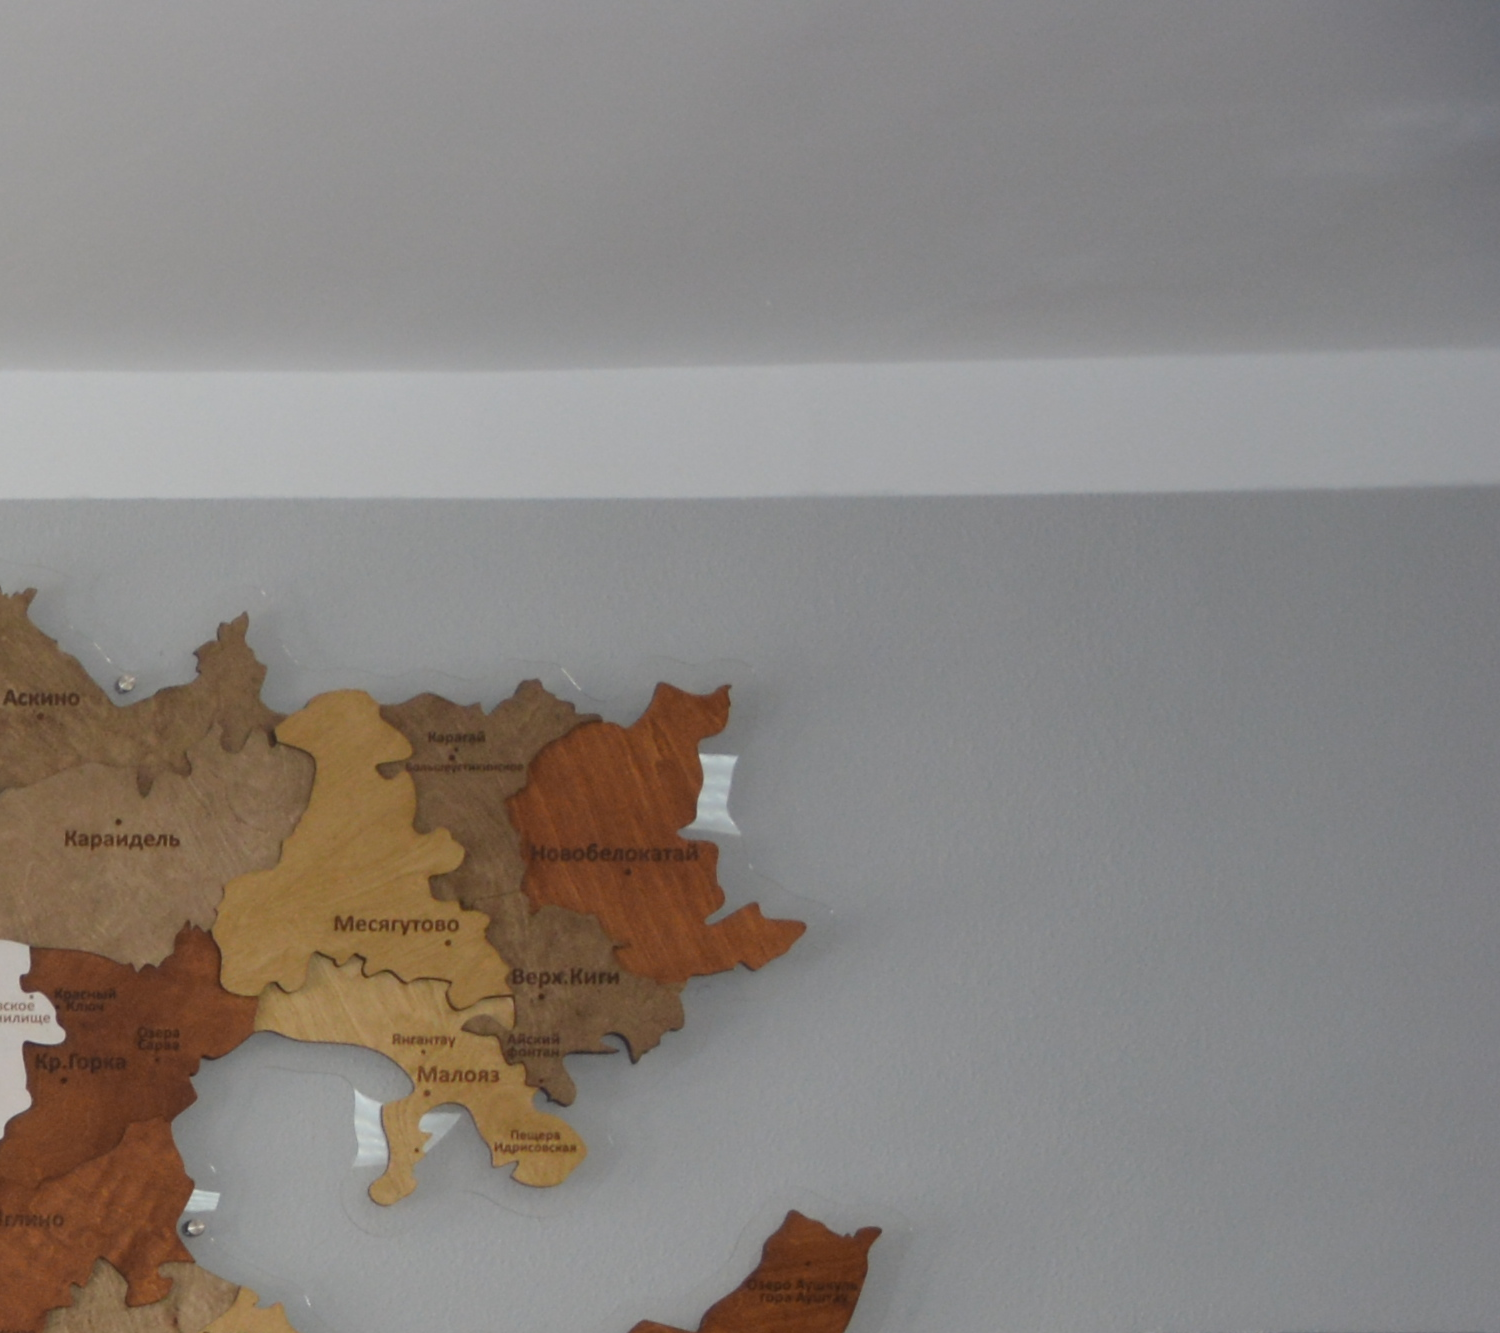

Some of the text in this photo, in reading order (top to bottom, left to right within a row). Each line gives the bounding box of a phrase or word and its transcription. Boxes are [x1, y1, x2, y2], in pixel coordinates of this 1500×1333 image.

[3, 689, 80, 707] Аскино
[64, 831, 181, 850] Караидель
[531, 844, 700, 862] Новобелокатай
[334, 915, 459, 935] Месягутово
[511, 968, 620, 987] Верх.Киги
[35, 1054, 126, 1072] Кр.Горка
[417, 1066, 500, 1084] Малояз
